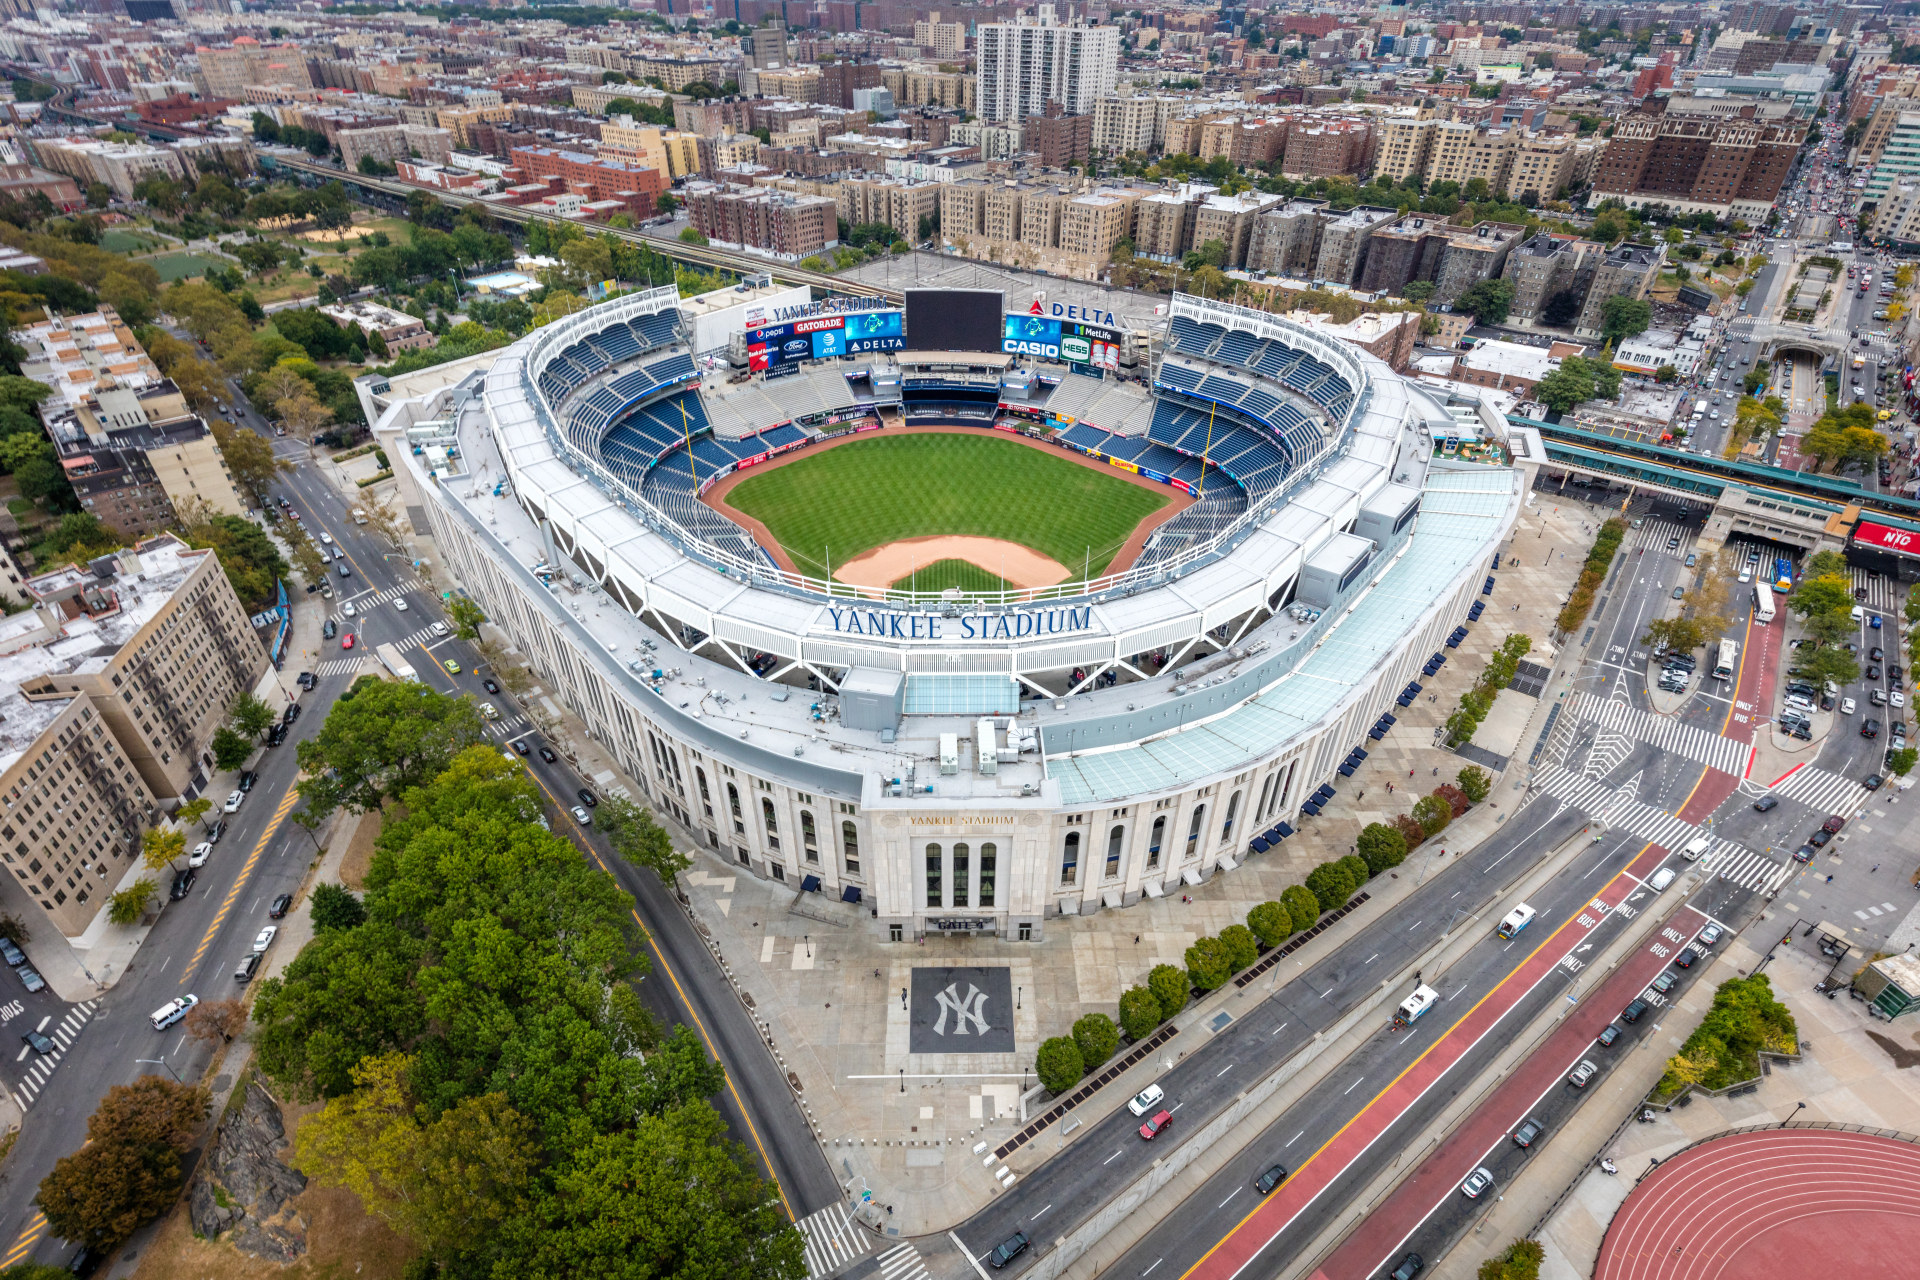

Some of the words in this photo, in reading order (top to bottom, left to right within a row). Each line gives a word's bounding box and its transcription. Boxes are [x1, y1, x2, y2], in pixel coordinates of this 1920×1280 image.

[773, 301, 822, 322] YANKEE
[829, 295, 887, 314] STADIUM
[1052, 302, 1115, 327] DELTA
[797, 318, 841, 331] GATORADE
[765, 327, 784, 339] pepsi
[1085, 327, 1111, 340] MetLife
[763, 346, 779, 354] America
[823, 346, 837, 354] AT&T
[863, 338, 903, 350] DELTA
[1004, 340, 1059, 358] CASIO
[1063, 343, 1087, 355] HESS
[700, 477, 716, 495] Canon
[1883, 531, 1911, 546] NYC
[828, 607, 942, 639] YANKEE
[961, 605, 1092, 639] STADIUM
[1609, 645, 1625, 654] ONLY
[1631, 651, 1647, 660] ONLY
[1735, 700, 1753, 711] ONLY
[1734, 712, 1748, 723] BUS
[910, 816, 956, 826] YANKEE
[961, 816, 1014, 826] STADIUM
[1589, 898, 1613, 914] ONLY
[1616, 902, 1639, 919] ONLY
[938, 920, 972, 929] GATE
[976, 920, 983, 929] 4
[1577, 913, 1596, 928] BUS
[1661, 927, 1686, 944] ONLY
[1649, 942, 1669, 958] BUS
[1561, 954, 1586, 973] ONLY
[1642, 988, 1669, 1008] ONLY
[0, 999, 25, 1022] STOP
[932, 982, 992, 1036] NY
